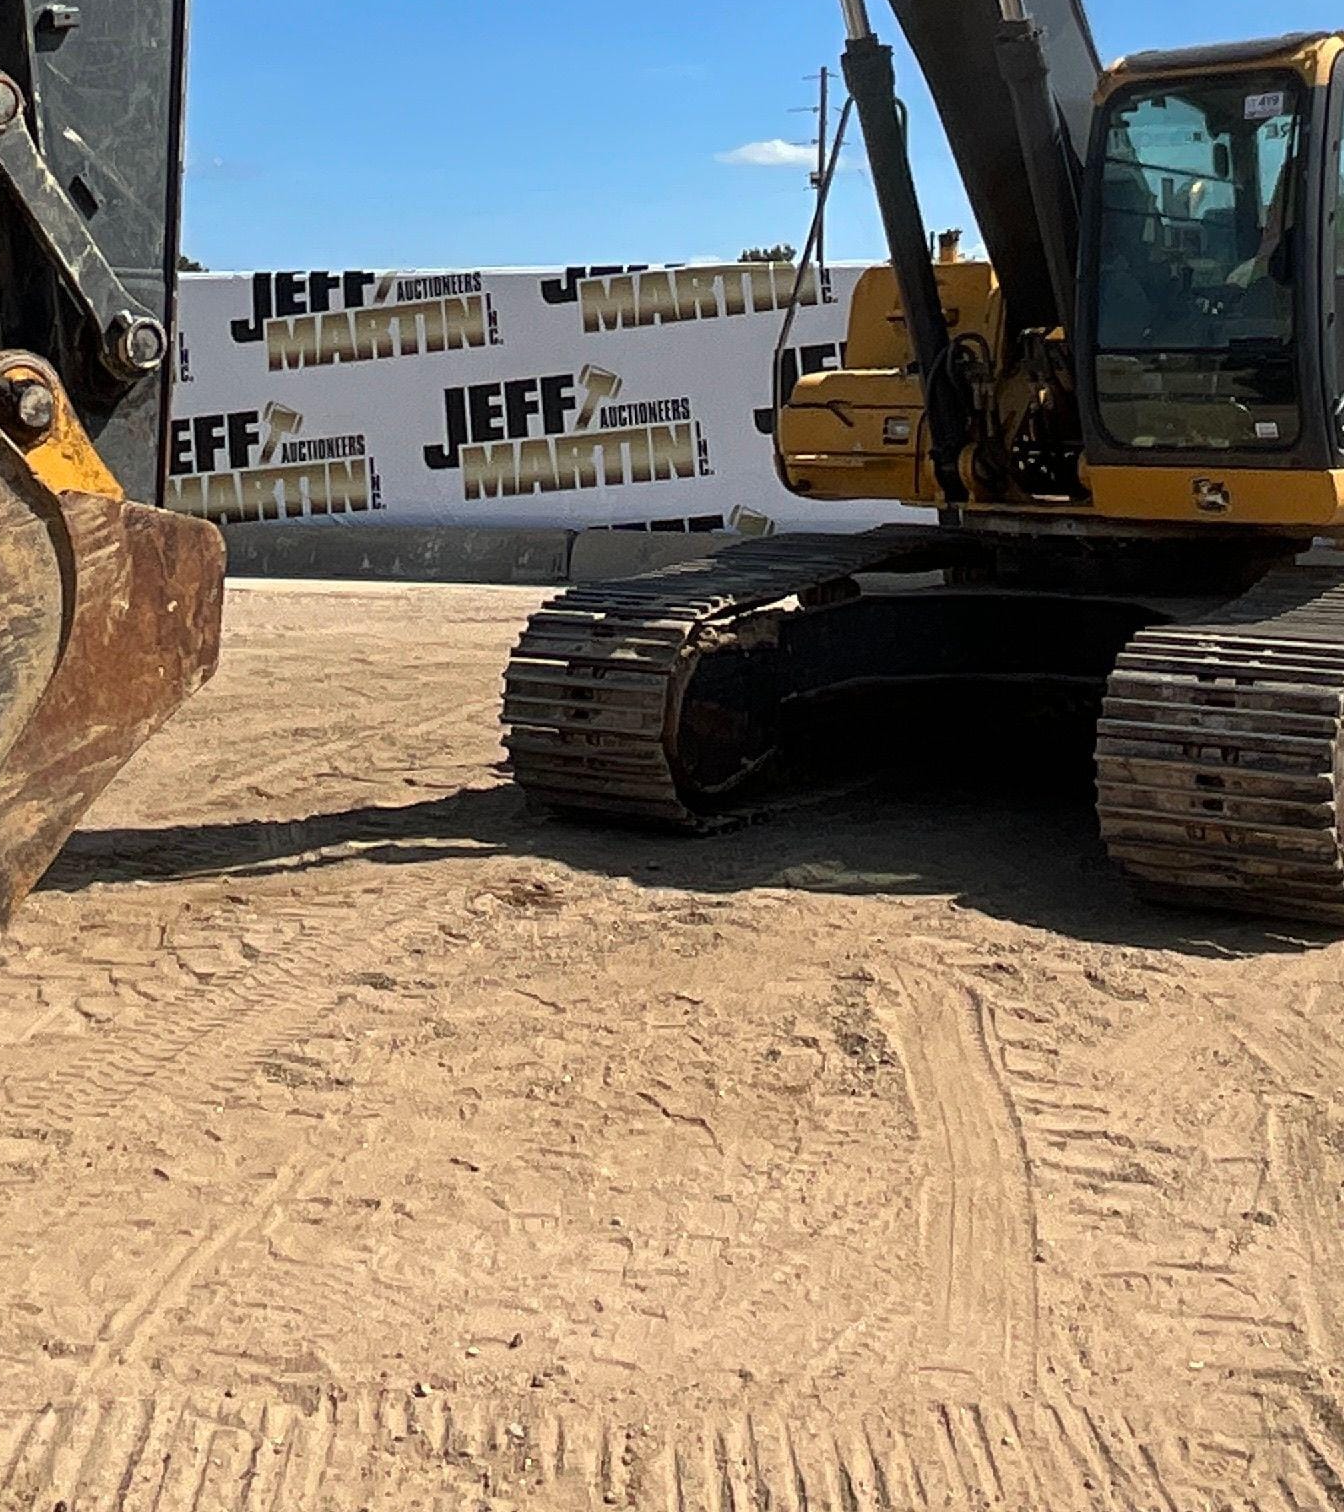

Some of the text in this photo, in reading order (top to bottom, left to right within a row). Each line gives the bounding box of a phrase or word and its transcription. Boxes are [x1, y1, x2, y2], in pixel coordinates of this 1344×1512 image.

[231, 271, 375, 343] JEFF
[397, 273, 481, 301] AUCTIONEERS
[267, 295, 485, 372] MARTIN
[169, 410, 260, 476] EFF
[423, 374, 575, 469] JEFF
[600, 397, 690, 429] AUCTIONEERS
[282, 434, 366, 464] AUCTIONEERS
[461, 423, 695, 501] MARTIN
